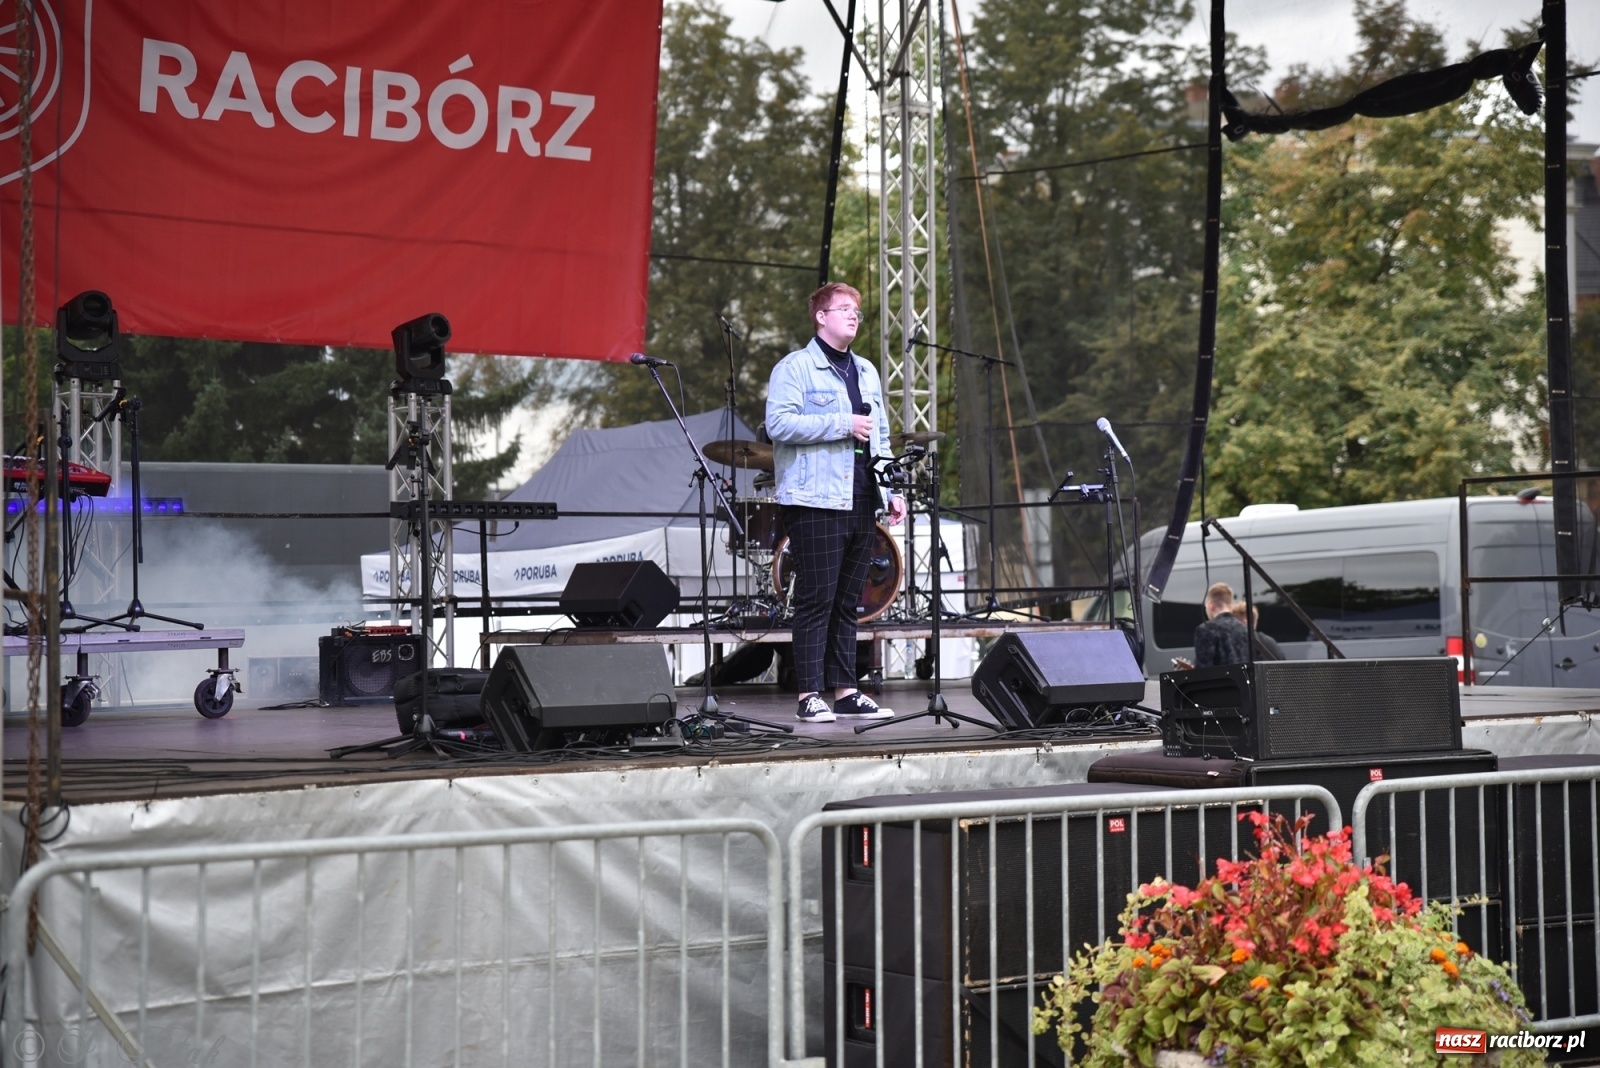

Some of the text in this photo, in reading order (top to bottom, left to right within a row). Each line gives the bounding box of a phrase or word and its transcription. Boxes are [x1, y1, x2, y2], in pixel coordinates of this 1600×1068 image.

[138, 37, 596, 162] RACIBÓRZ
[452, 569, 480, 583] ORUBA
[520, 564, 557, 580] PORUBA
[372, 649, 392, 663] EBS
[1110, 820, 1124, 828] POL
